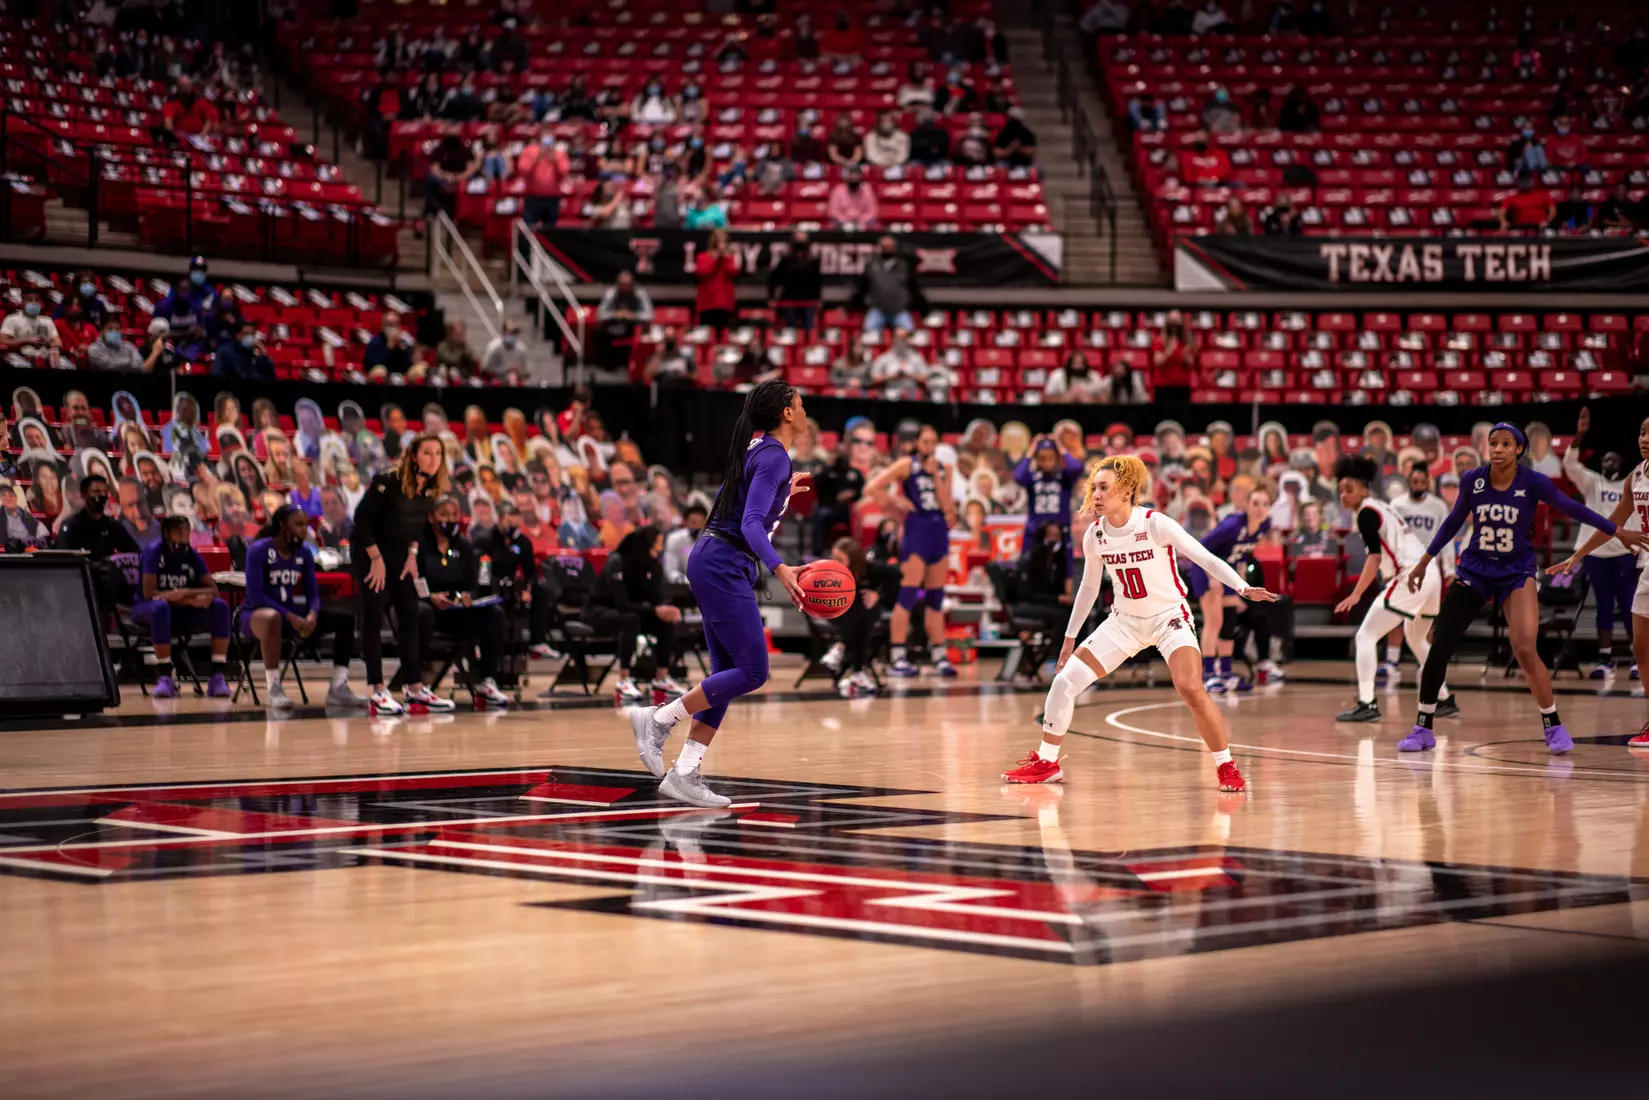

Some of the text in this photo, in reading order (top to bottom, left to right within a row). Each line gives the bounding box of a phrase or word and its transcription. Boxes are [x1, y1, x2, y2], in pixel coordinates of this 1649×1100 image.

[1320, 244, 1551, 282] TEXAS TECH
[1477, 503, 1519, 525] TCU
[1403, 515, 1434, 532] TCU
[1479, 525, 1513, 552] 23
[1101, 549, 1154, 565] TEXAS TECH
[269, 568, 302, 586] TCU
[813, 579, 842, 589] NCAA
[1115, 567, 1148, 600] 10
[808, 596, 847, 608] Wilson
